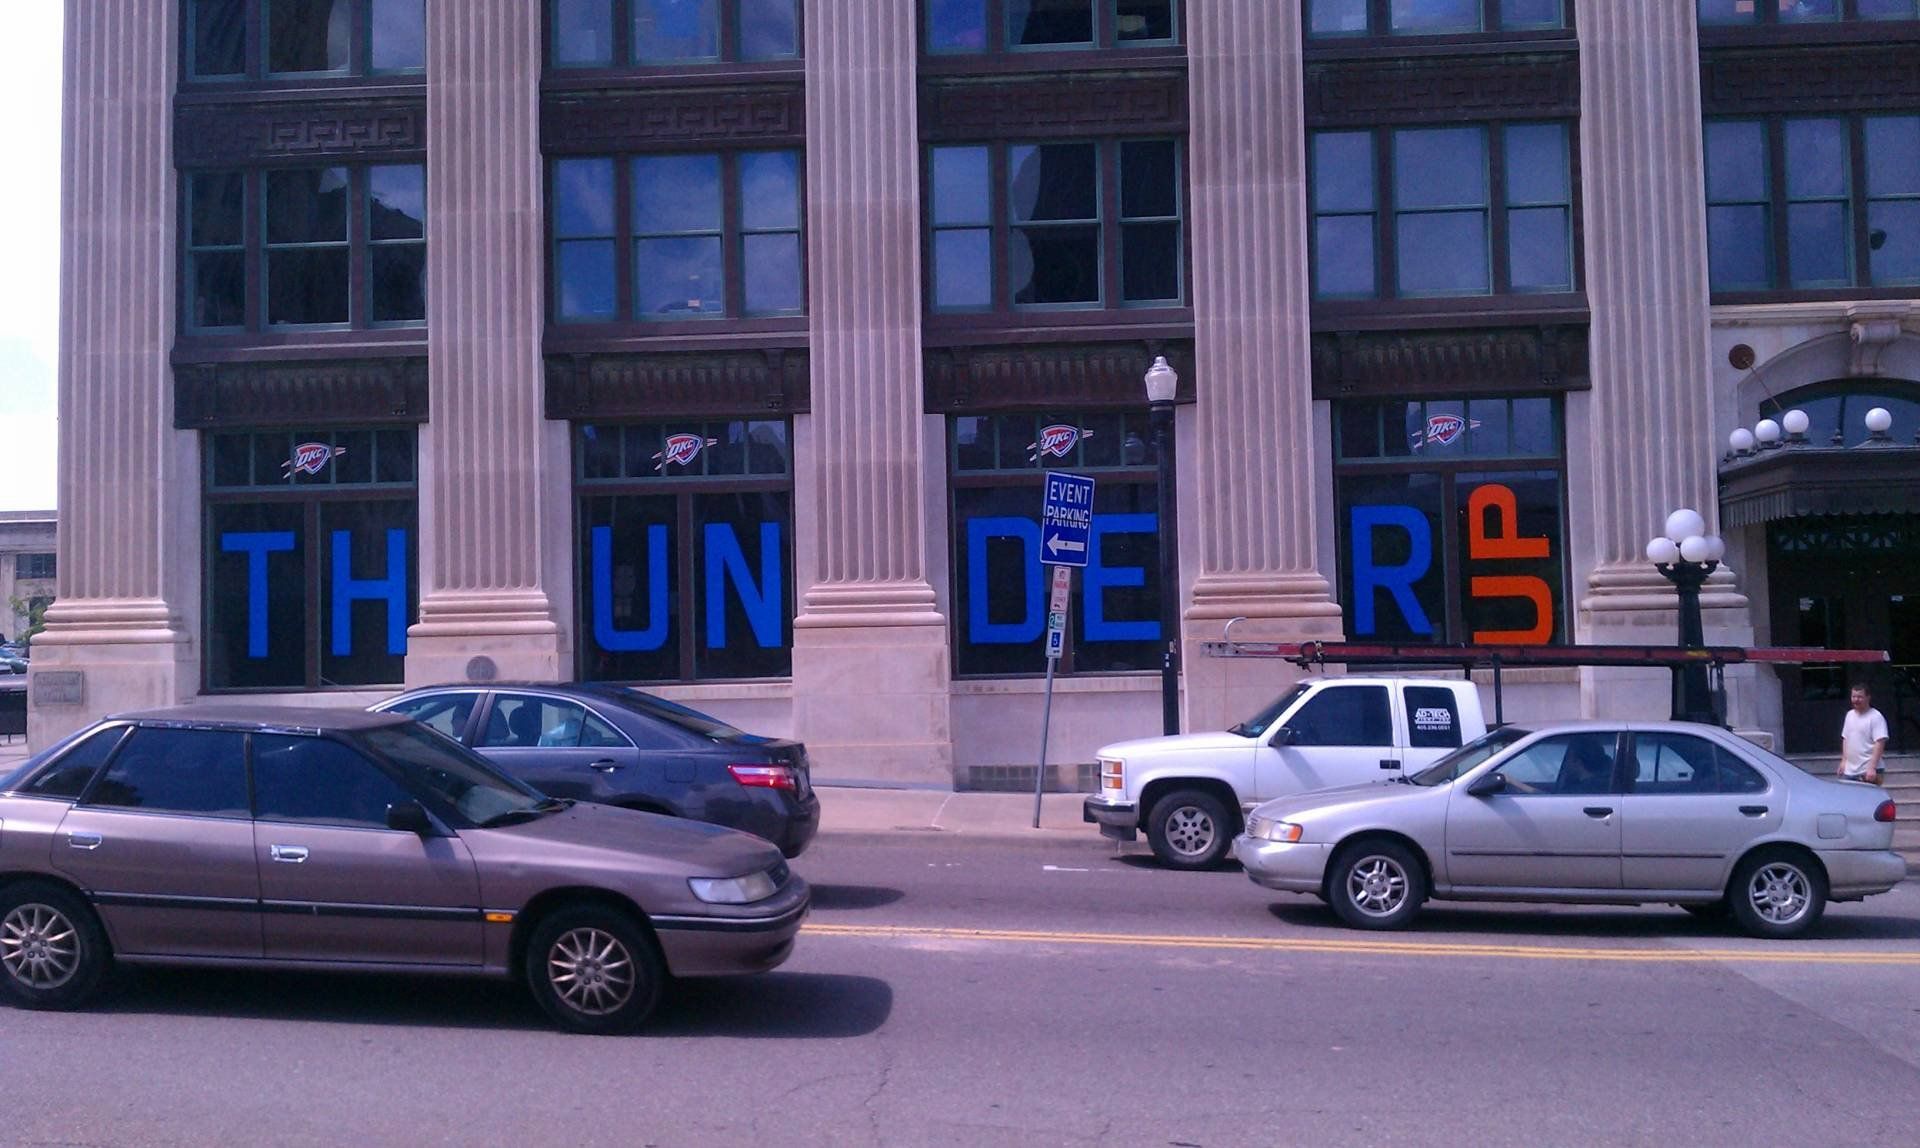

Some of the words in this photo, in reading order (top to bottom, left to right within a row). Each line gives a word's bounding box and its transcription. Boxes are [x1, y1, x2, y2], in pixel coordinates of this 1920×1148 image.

[1050, 481, 1090, 504] EVENT
[1045, 504, 1089, 529] PARKING
[1468, 484, 1554, 645] UP
